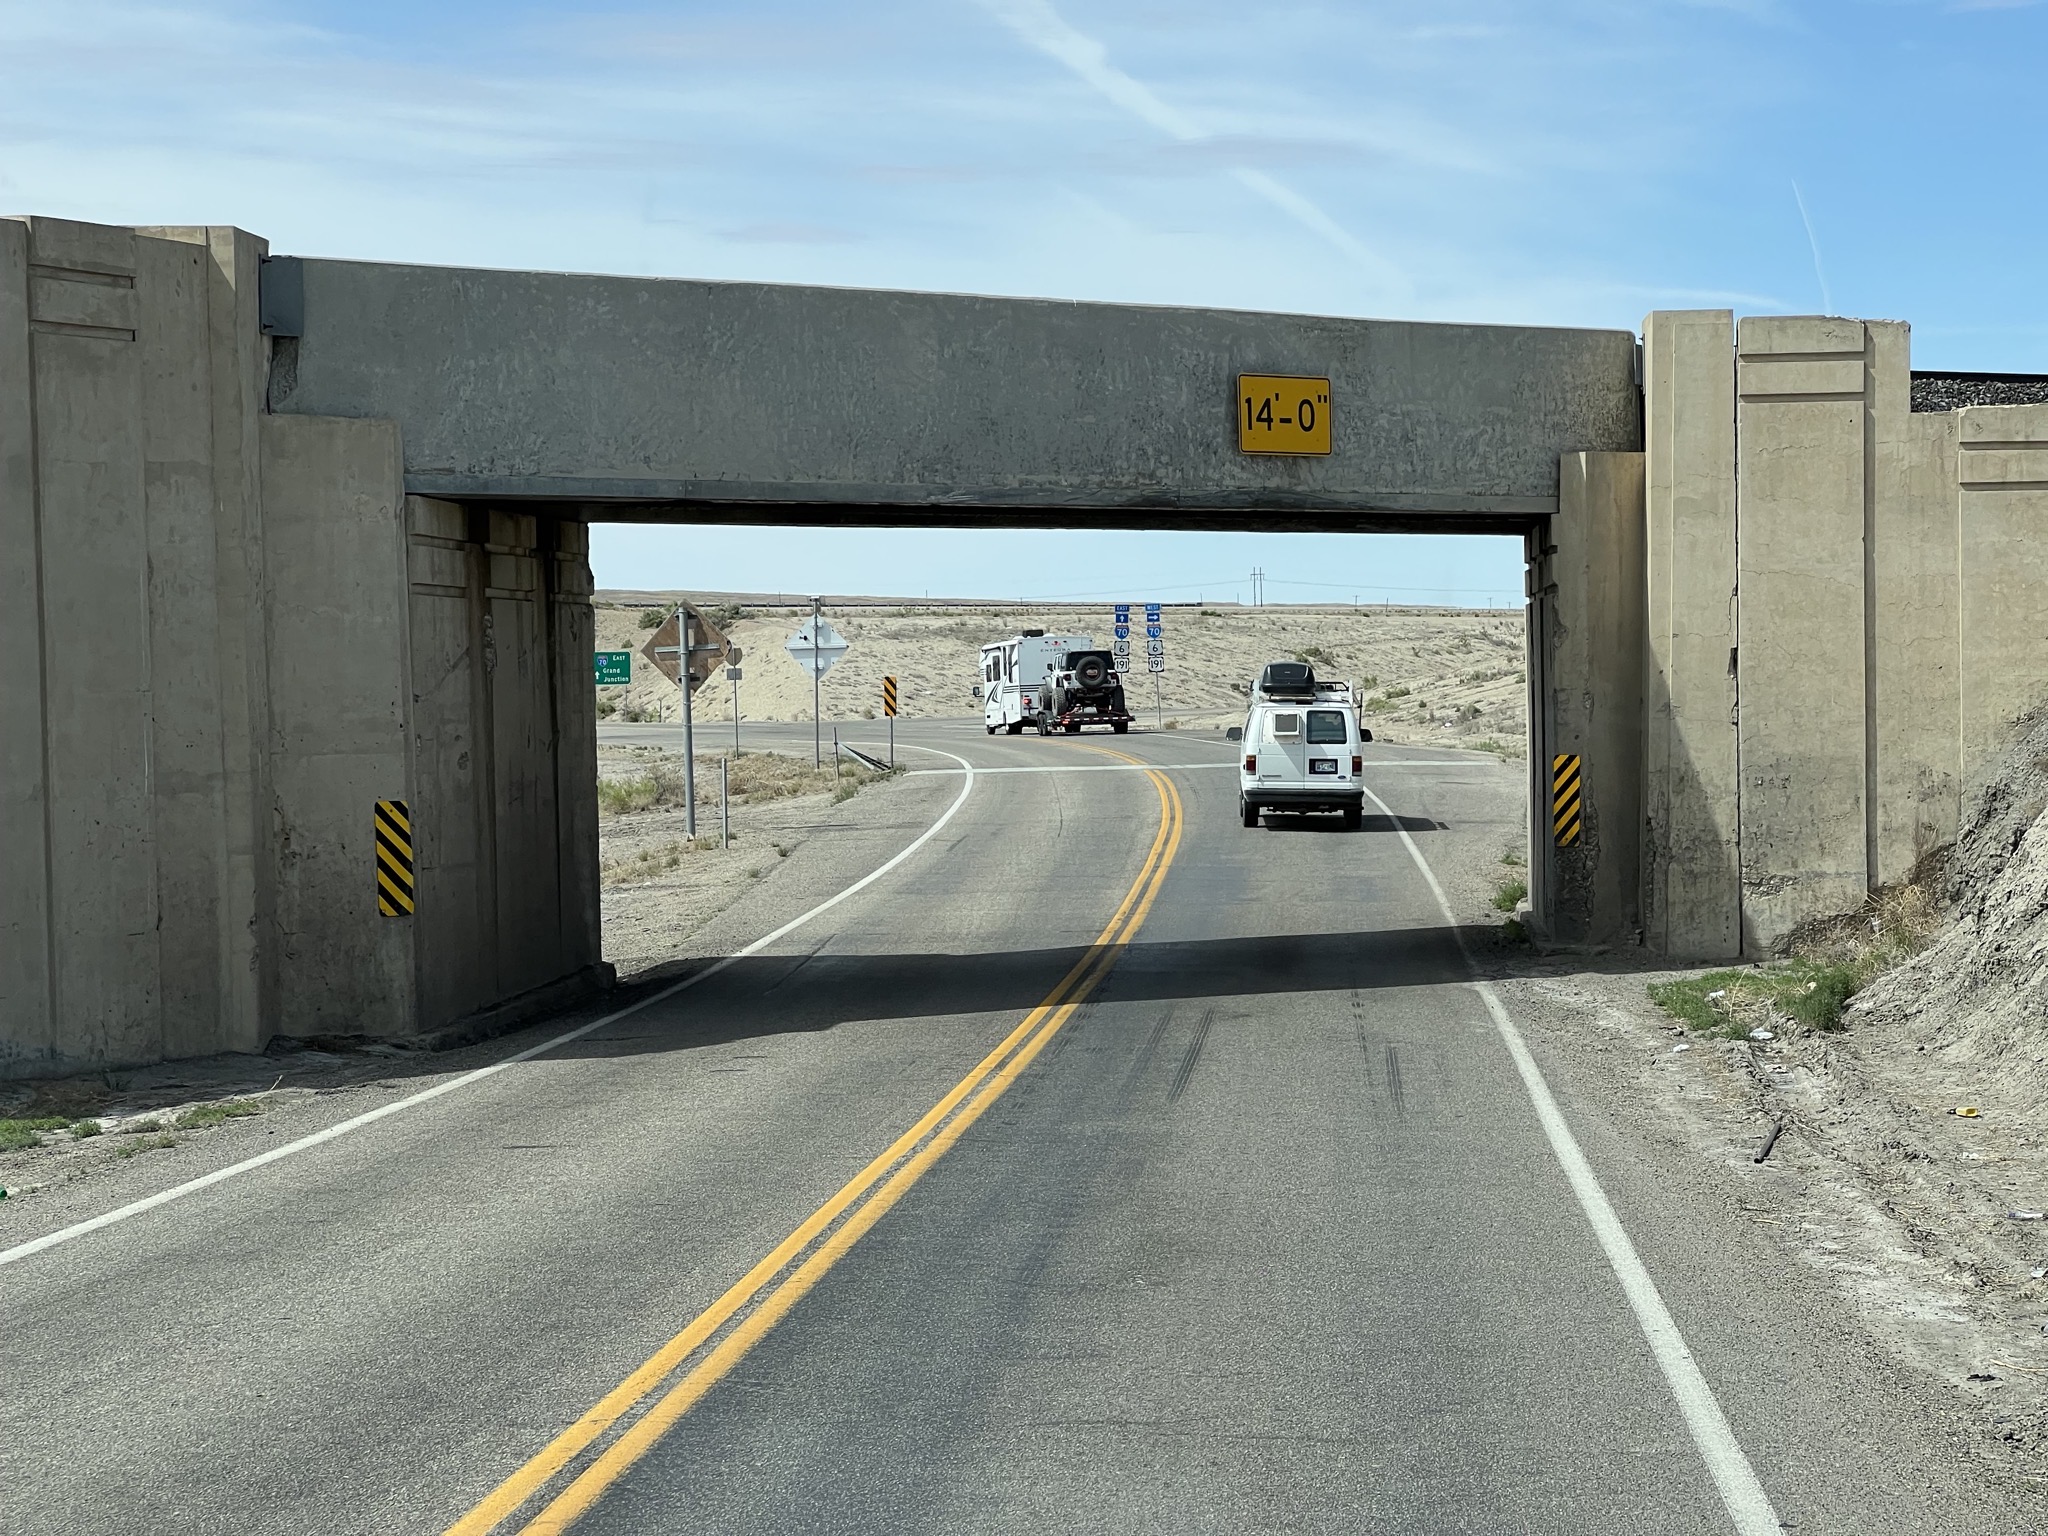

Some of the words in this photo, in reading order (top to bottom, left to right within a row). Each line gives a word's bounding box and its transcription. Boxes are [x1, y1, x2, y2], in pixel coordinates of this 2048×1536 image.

[1117, 628, 1128, 637] 70
[1149, 628, 1160, 636] 70
[1119, 645, 1125, 653] 6
[1152, 644, 1158, 652] 6
[1116, 661, 1127, 669] 191
[1151, 660, 1162, 669] 191
